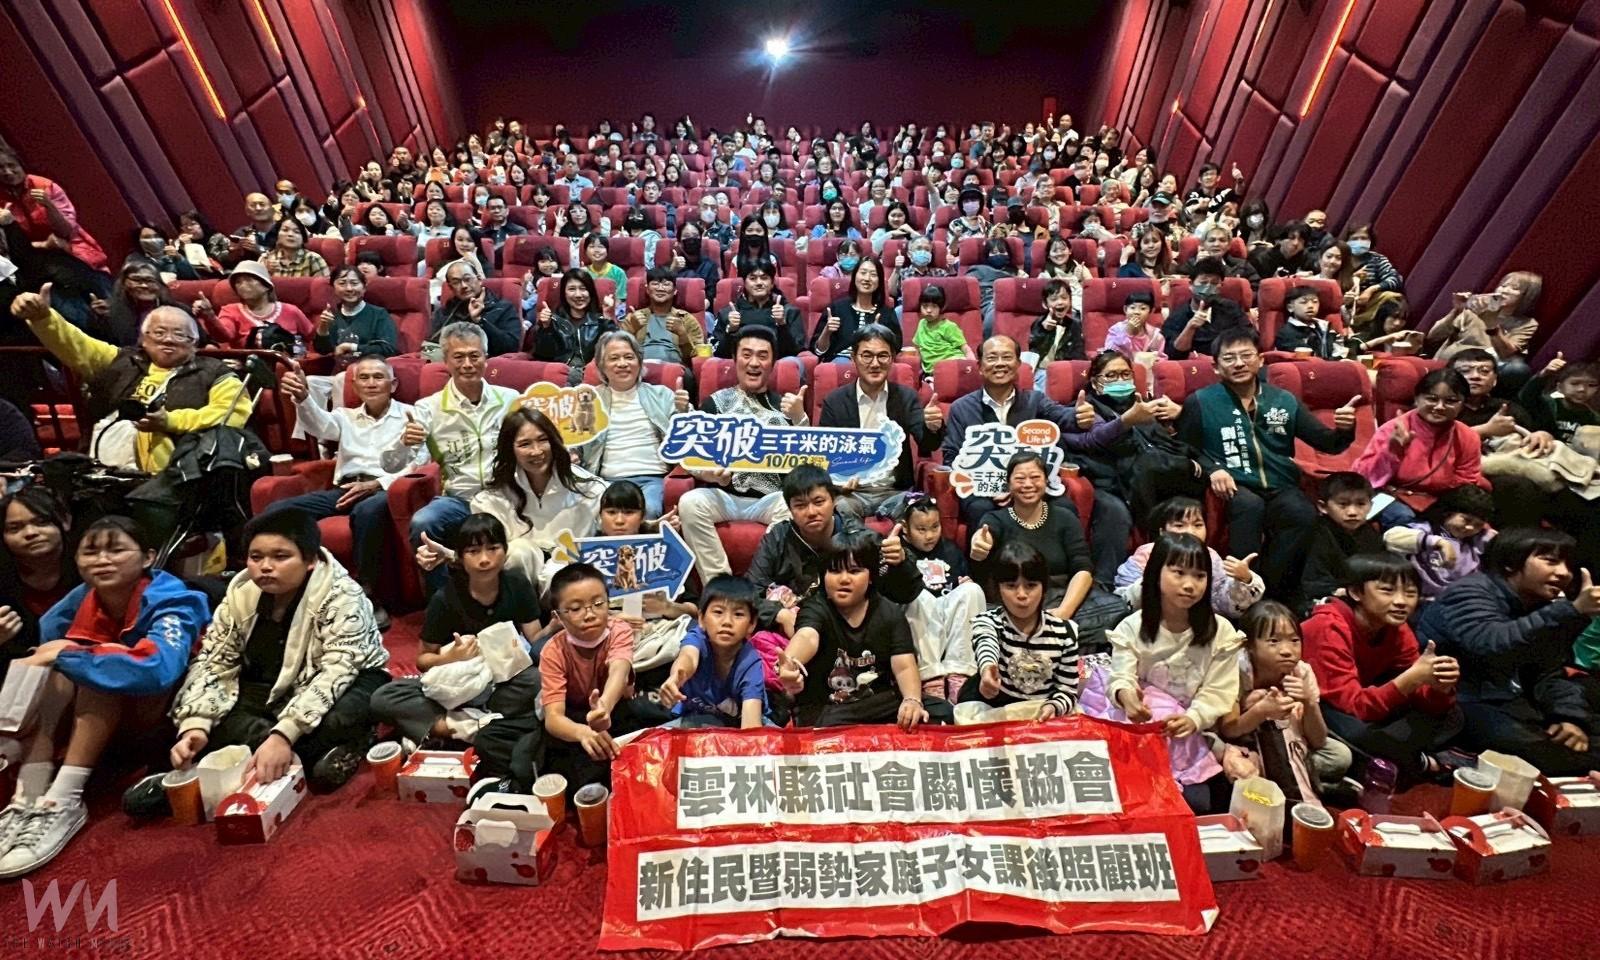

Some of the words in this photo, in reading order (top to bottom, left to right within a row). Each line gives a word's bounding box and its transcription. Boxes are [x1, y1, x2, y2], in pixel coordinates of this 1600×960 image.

[491, 368, 498, 377] 9
[724, 366, 730, 375] 7
[844, 370, 851, 379] 6
[1308, 371, 1315, 379] 2
[1022, 426, 1051, 435] Second
[664, 418, 761, 464] 突破
[760, 431, 878, 455] 三千米的泳氣
[1027, 435, 1042, 444] Life
[973, 471, 1008, 482] 三千米
[679, 750, 1113, 817] 雲林縣社會關懷協會
[638, 839, 1176, 910] 新住民暨弱勢家庭子女課後照顧班
